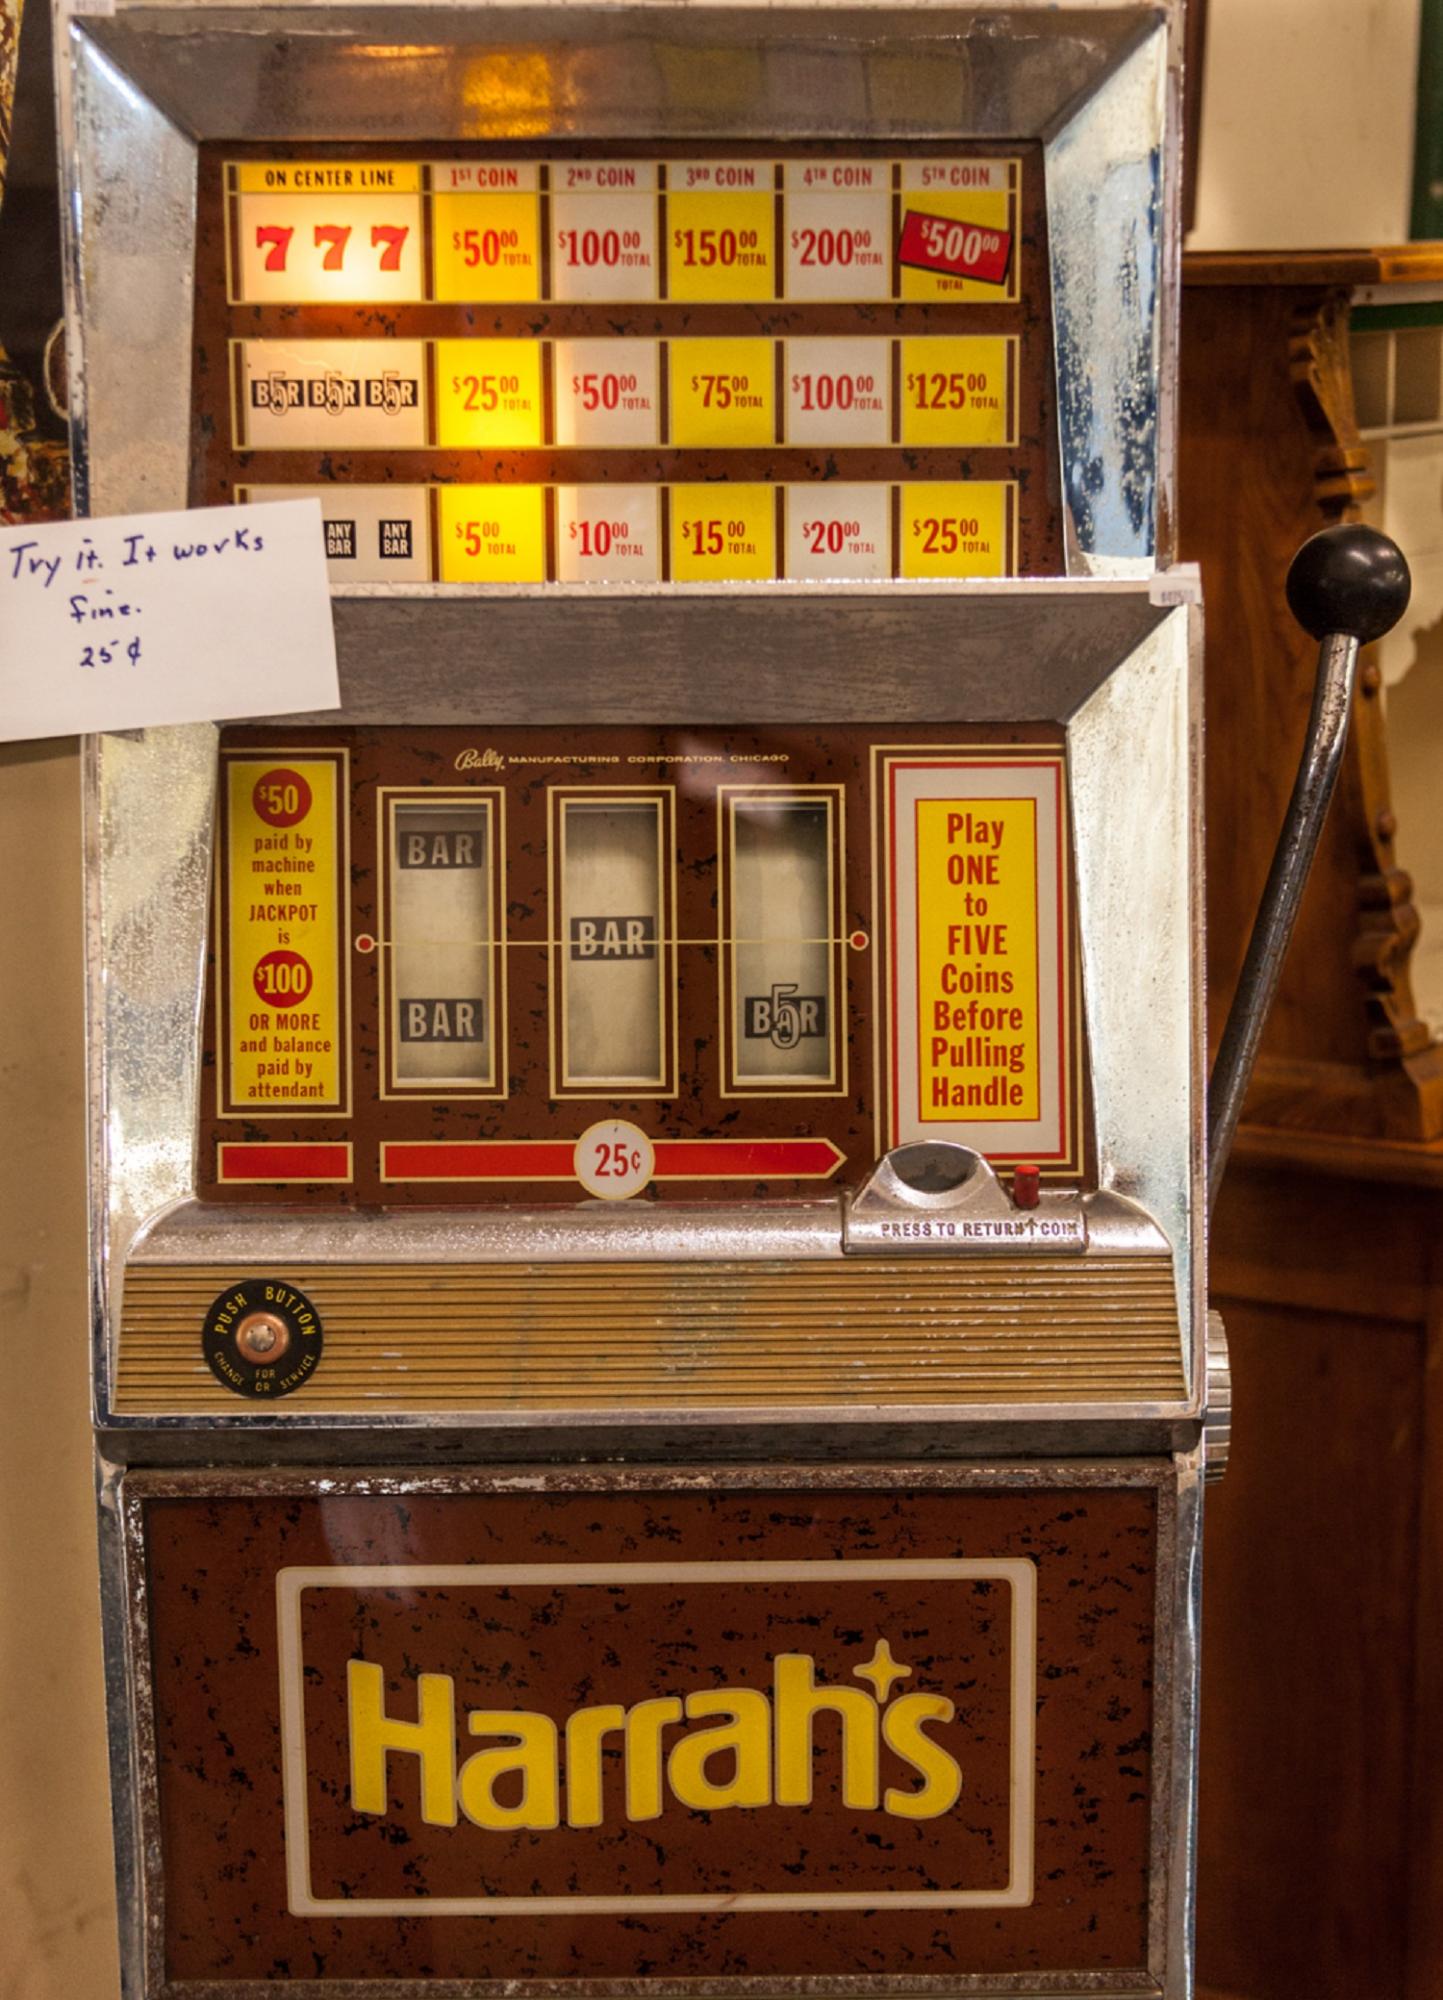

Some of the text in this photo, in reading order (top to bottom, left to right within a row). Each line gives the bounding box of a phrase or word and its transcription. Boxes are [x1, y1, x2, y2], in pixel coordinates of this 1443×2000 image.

[265, 169, 395, 187] ON CENTER LINE
[477, 167, 518, 187] COIN
[597, 167, 635, 187] COIN
[715, 167, 755, 186] COIN
[833, 167, 872, 186] COIN
[951, 166, 990, 185] COIN
[256, 225, 409, 272] 7 7 7
[504, 253, 532, 266] TOTAL
[621, 253, 651, 267] TOTAL
[737, 253, 767, 266] TOTAL
[854, 253, 883, 266] TOTAL
[936, 279, 963, 291] TOTAL
[503, 399, 531, 411] TOTAL
[622, 397, 650, 410] TOTAL
[734, 395, 763, 408] TOTAL
[854, 398, 883, 411] TOTAL
[970, 396, 998, 409] TOTAL
[328, 523, 351, 538] ANY
[384, 523, 407, 538] ANY
[328, 539, 351, 554] BAR
[384, 539, 407, 554] BAR
[488, 544, 516, 555] TOTAL
[615, 544, 643, 556] TOTAL
[728, 543, 756, 555] TOTAL
[848, 543, 875, 554] TOTAL
[962, 541, 990, 553] TOTAL
[10, 542, 61, 588] Try
[123, 535, 156, 566] It
[70, 589, 142, 623] fine.
[508, 756, 620, 764] MANUFACTURING
[730, 754, 789, 762] CHICAGO
[259, 785, 299, 815] $50
[947, 813, 1004, 850] Play
[255, 833, 313, 853] paid by
[407, 834, 474, 865] BAR
[252, 857, 315, 872] machine
[947, 854, 1000, 885] ONE
[264, 880, 302, 895] when
[249, 904, 318, 921] JACKPOT
[964, 892, 988, 917] to
[278, 928, 290, 944] is
[578, 920, 646, 956] BAR
[948, 925, 1007, 955] FIVE
[257, 963, 307, 994] $100
[941, 963, 1014, 994] Coins
[250, 1014, 320, 1031] OR MORE
[408, 1002, 474, 1037] BAR
[933, 1000, 1023, 1031] Before
[240, 1037, 331, 1053] and balance
[932, 1037, 1025, 1073] Pulling
[257, 1059, 313, 1078] paid by
[248, 1082, 324, 1097] attendant
[932, 1076, 1023, 1107] Handle
[595, 1143, 641, 1178] 25¢
[881, 1222, 1077, 1237] PRESS TO RETURN COIN
[214, 1286, 316, 1335] PUSH BUTTON
[214, 1351, 244, 1386] CHANGE
